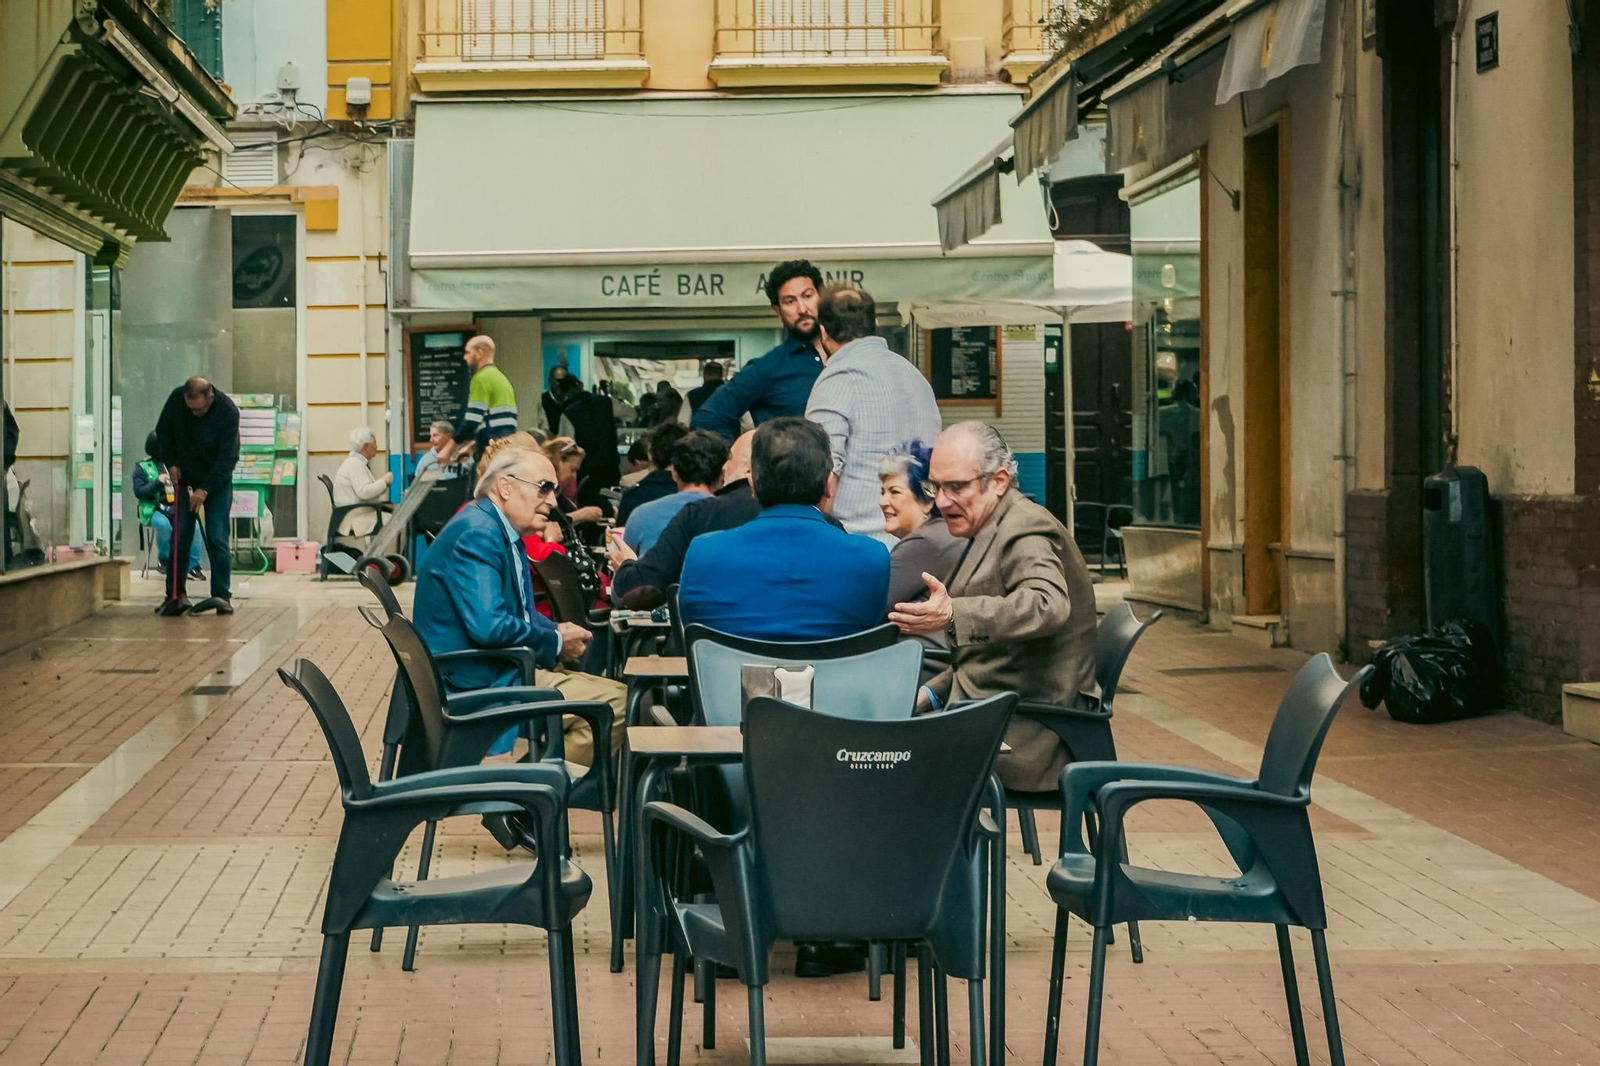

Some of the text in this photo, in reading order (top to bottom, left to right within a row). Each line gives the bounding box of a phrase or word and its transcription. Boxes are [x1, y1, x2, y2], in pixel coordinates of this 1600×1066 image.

[601, 268, 661, 296] CAFÉ
[677, 273, 724, 296] BAR
[836, 748, 911, 764] Cruzcampo
